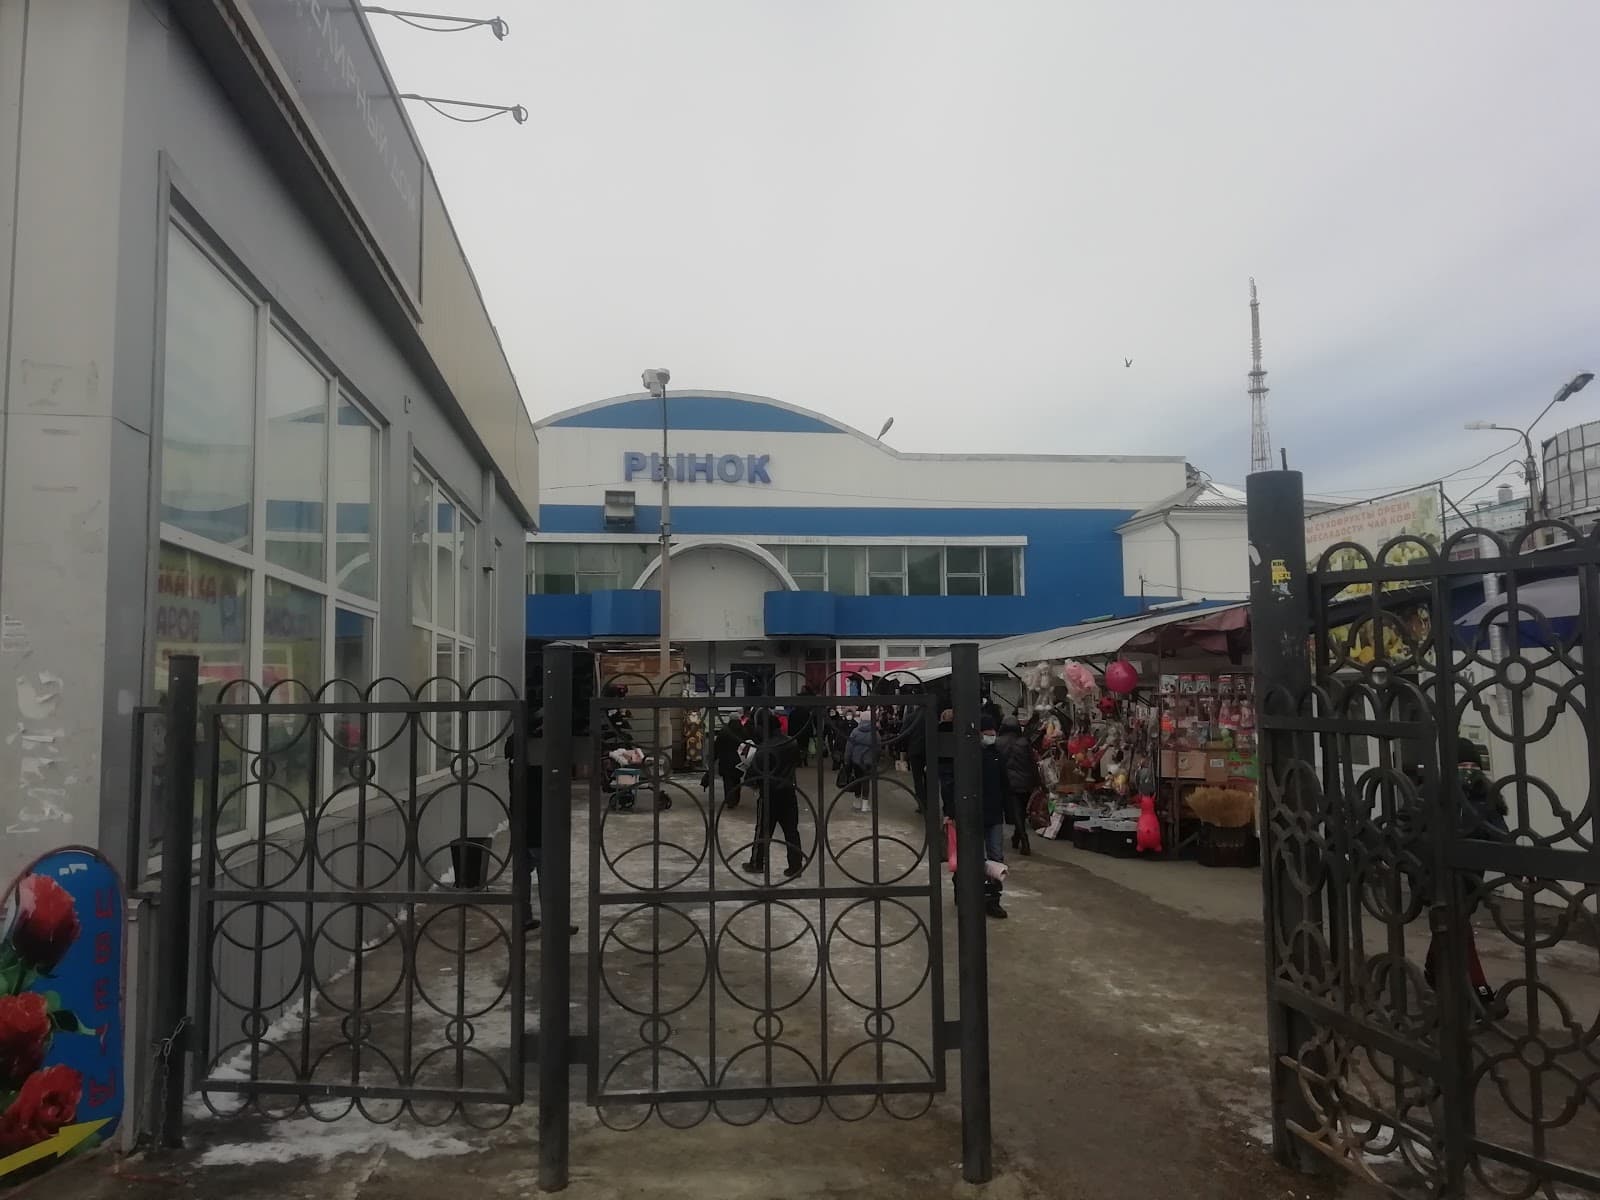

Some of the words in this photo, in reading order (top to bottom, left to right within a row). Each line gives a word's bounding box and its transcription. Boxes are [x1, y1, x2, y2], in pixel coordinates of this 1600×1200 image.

[624, 451, 772, 484] РЫНОК
[1314, 511, 1375, 531] СУХОФРУКТЫ
[1377, 502, 1410, 516] ОРЕХИ
[1367, 518, 1387, 529] ЧАЙ
[1390, 511, 1417, 524] КОФЕ
